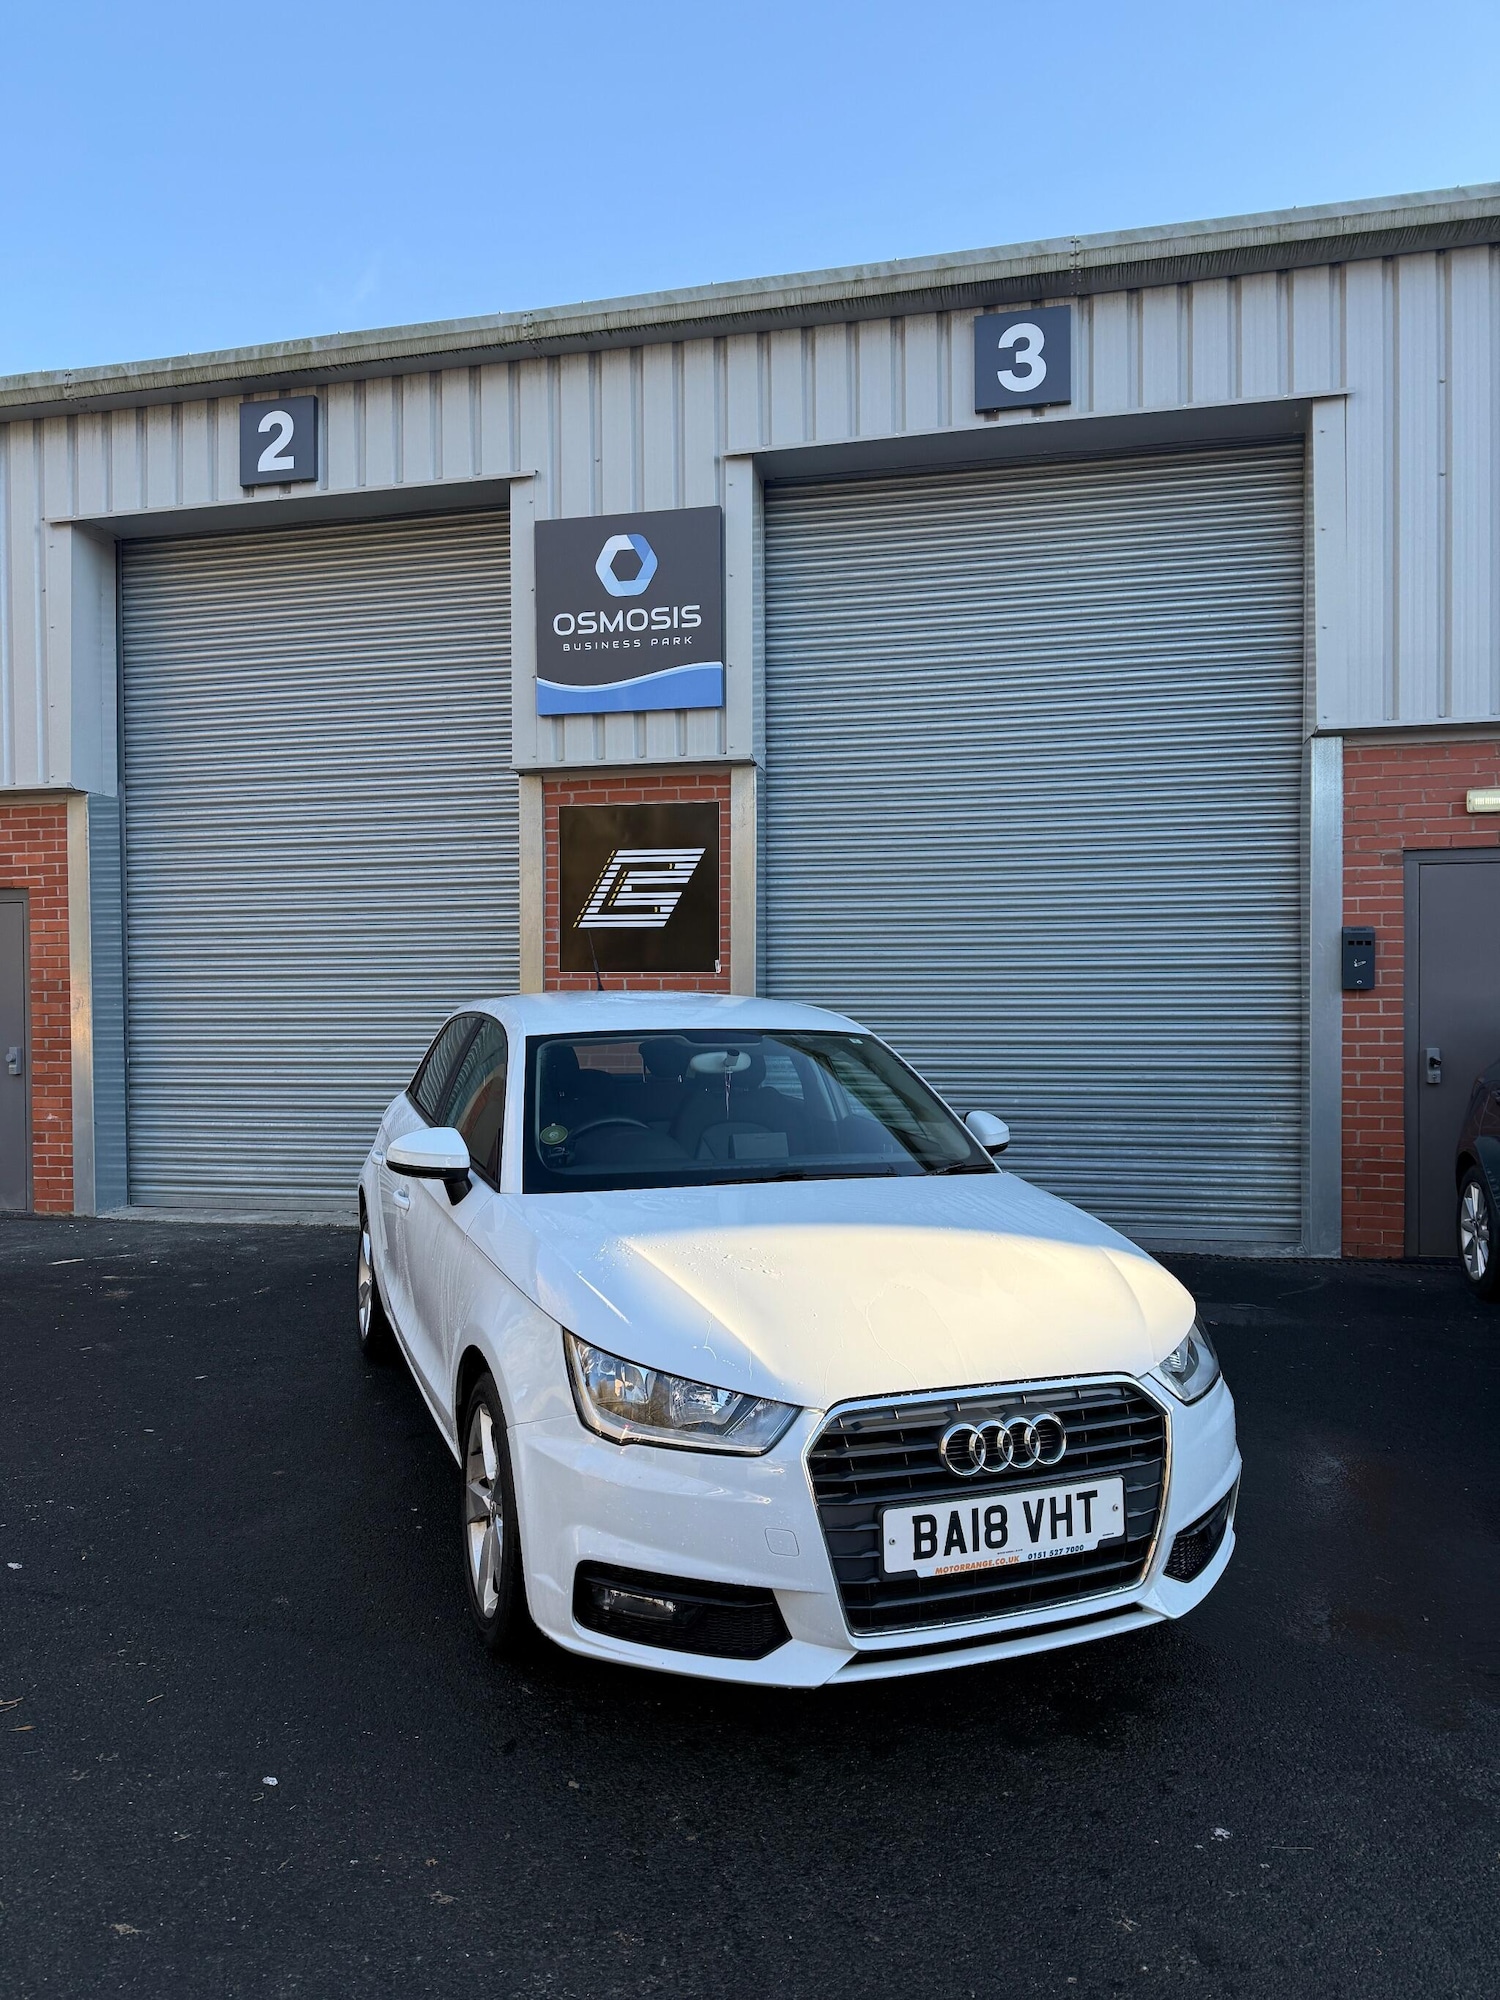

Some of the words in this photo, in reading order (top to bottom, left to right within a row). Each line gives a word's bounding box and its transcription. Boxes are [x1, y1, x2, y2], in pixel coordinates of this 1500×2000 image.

[997, 322, 1047, 393] 3
[257, 410, 295, 472] 2
[553, 604, 703, 637] OSMOSIS
[562, 638, 642, 652] BUSINESS
[650, 636, 693, 647] PARK
[912, 1503, 1008, 1561] BA18
[1022, 1489, 1098, 1544] VHT
[934, 1555, 1020, 1575] MOTORRANGE.CO.UK
[1027, 1550, 1047, 1561] 0151
[1049, 1547, 1064, 1558] 527
[1065, 1544, 1085, 1555] 7000
